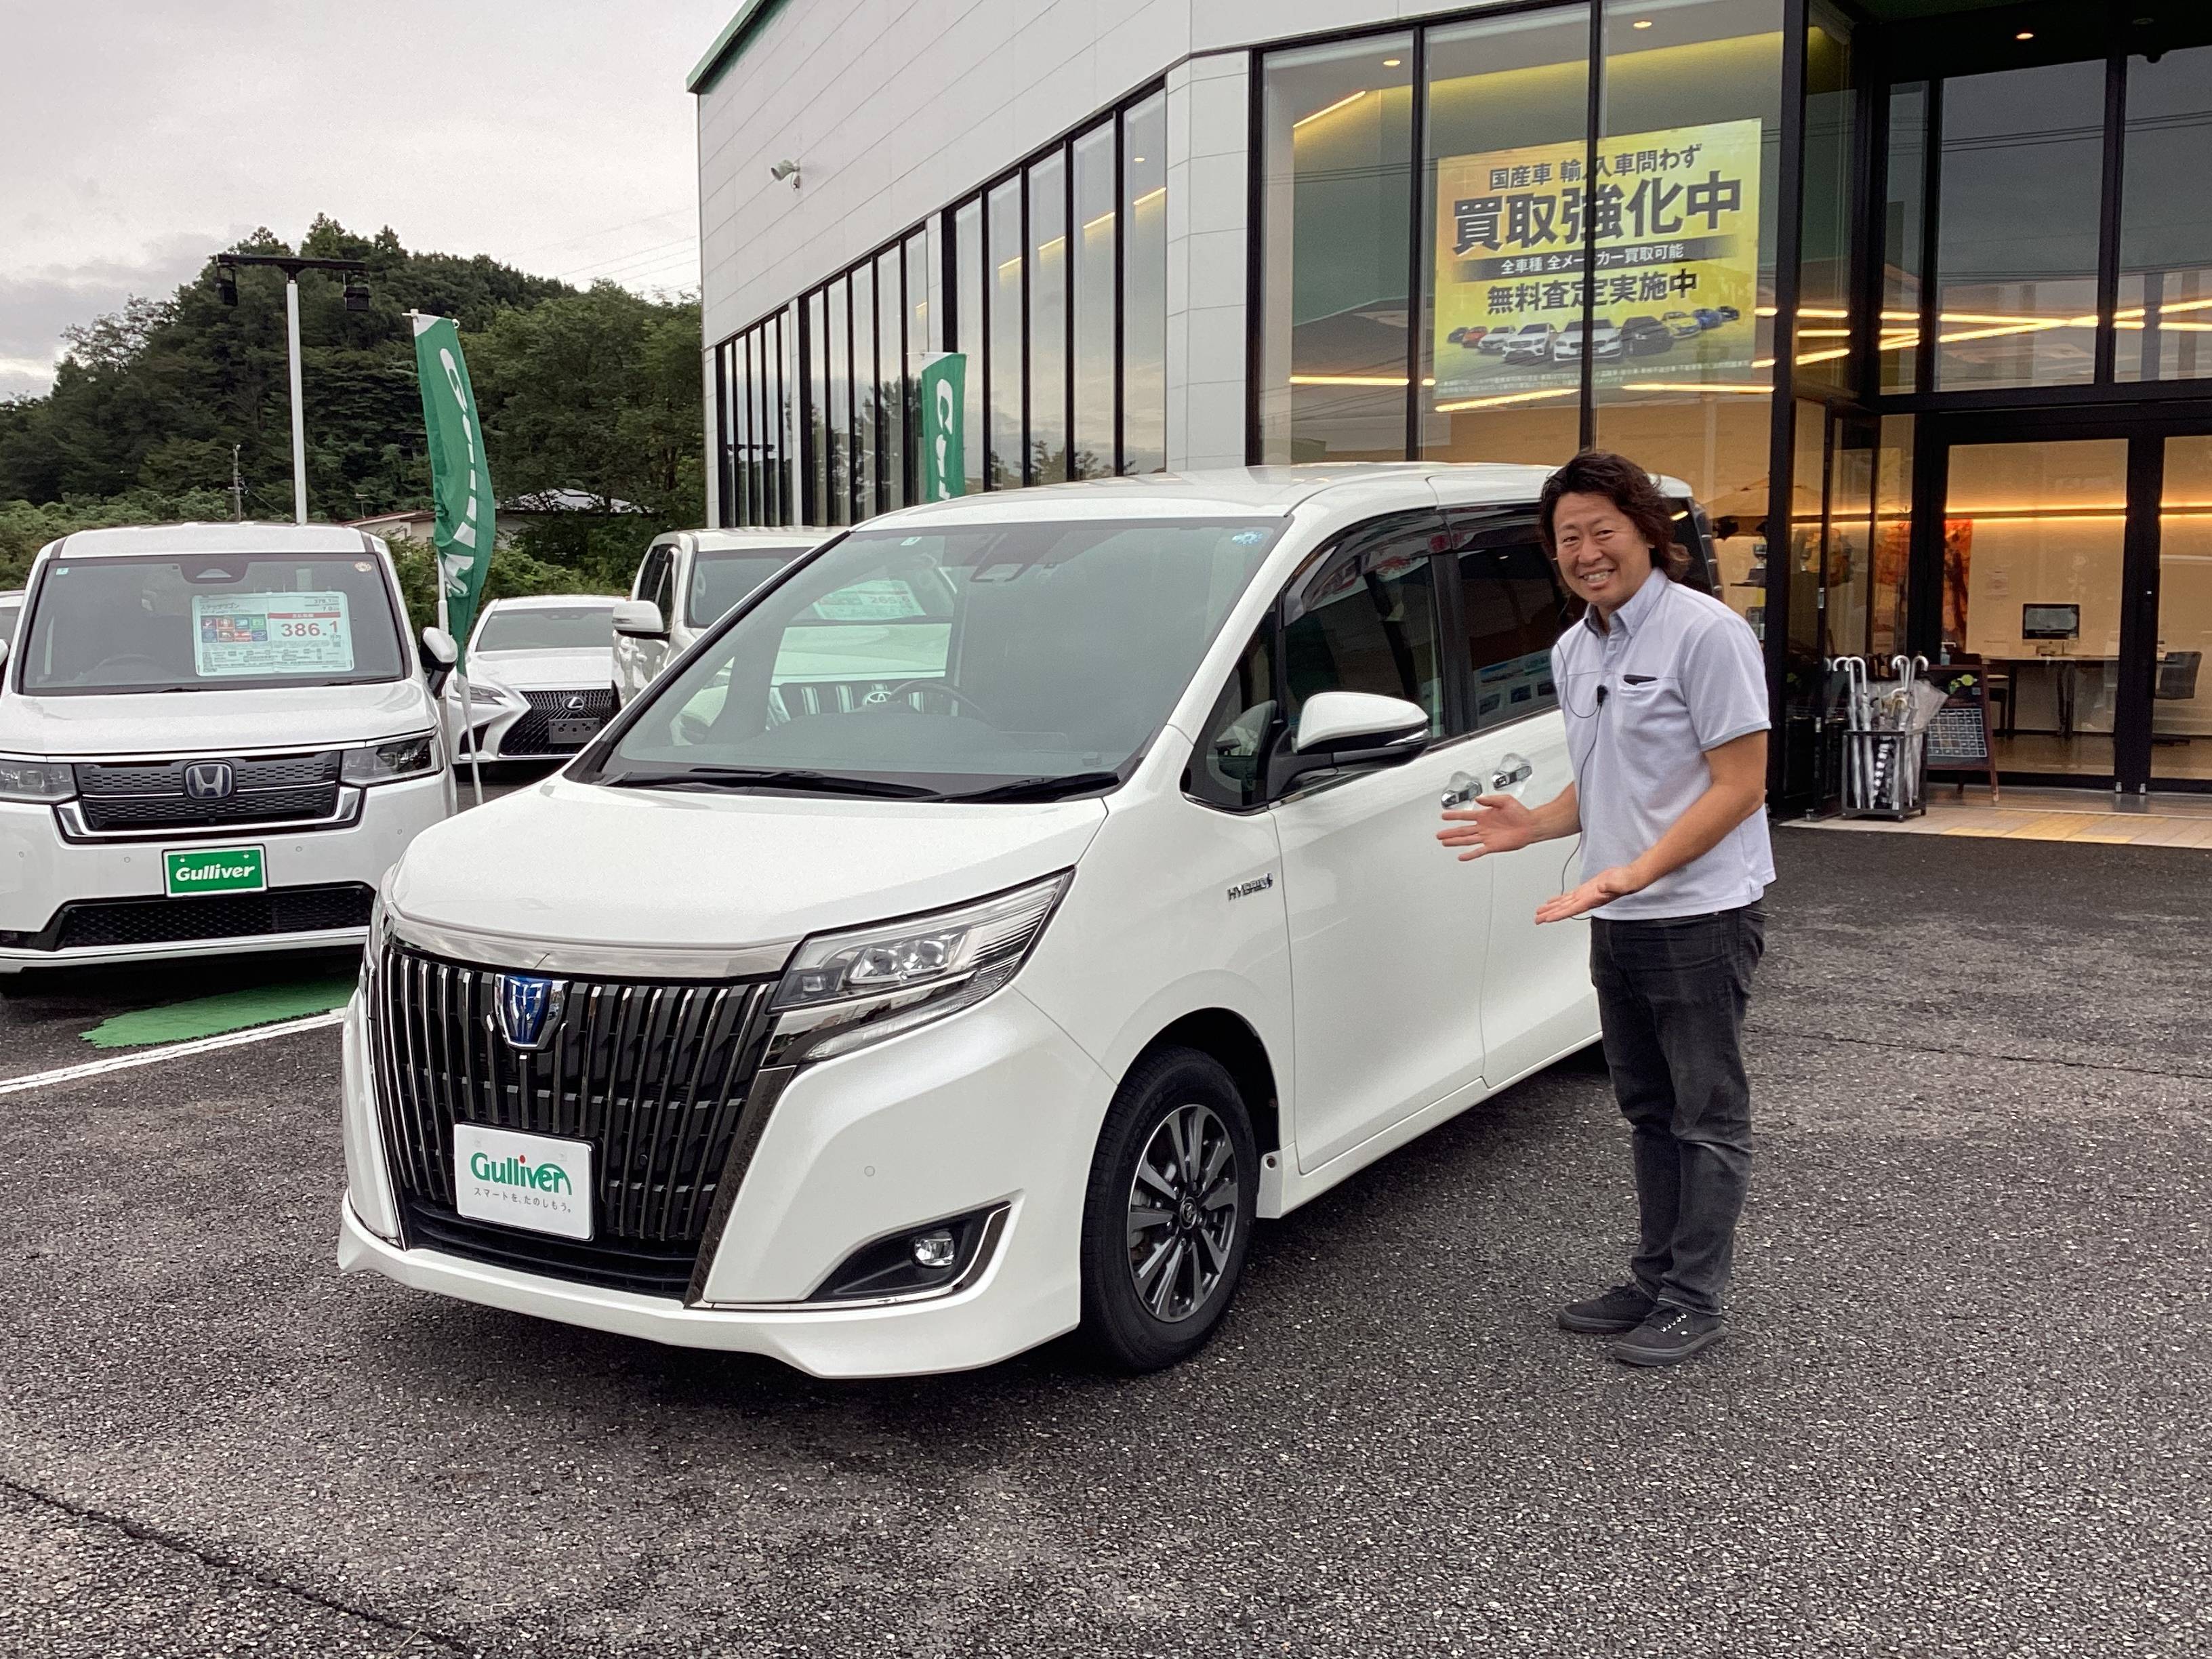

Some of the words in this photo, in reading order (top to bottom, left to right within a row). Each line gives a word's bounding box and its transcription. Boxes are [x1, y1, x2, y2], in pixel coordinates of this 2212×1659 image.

[1490, 162, 1553, 191] 国産車
[1560, 143, 1702, 183] 輸入車問わず
[1452, 169, 1742, 255] 買取強化中
[1500, 257, 1544, 275] 全車種
[1547, 243, 1684, 271] 全メーカー買取可能
[1488, 268, 1698, 315] 無料査定実施中
[281, 620, 339, 638] 386.1
[176, 863, 255, 882] Gulliver
[470, 1152, 572, 1196] Gulliver
[474, 1187, 571, 1213] スマートを、たのしもう。
